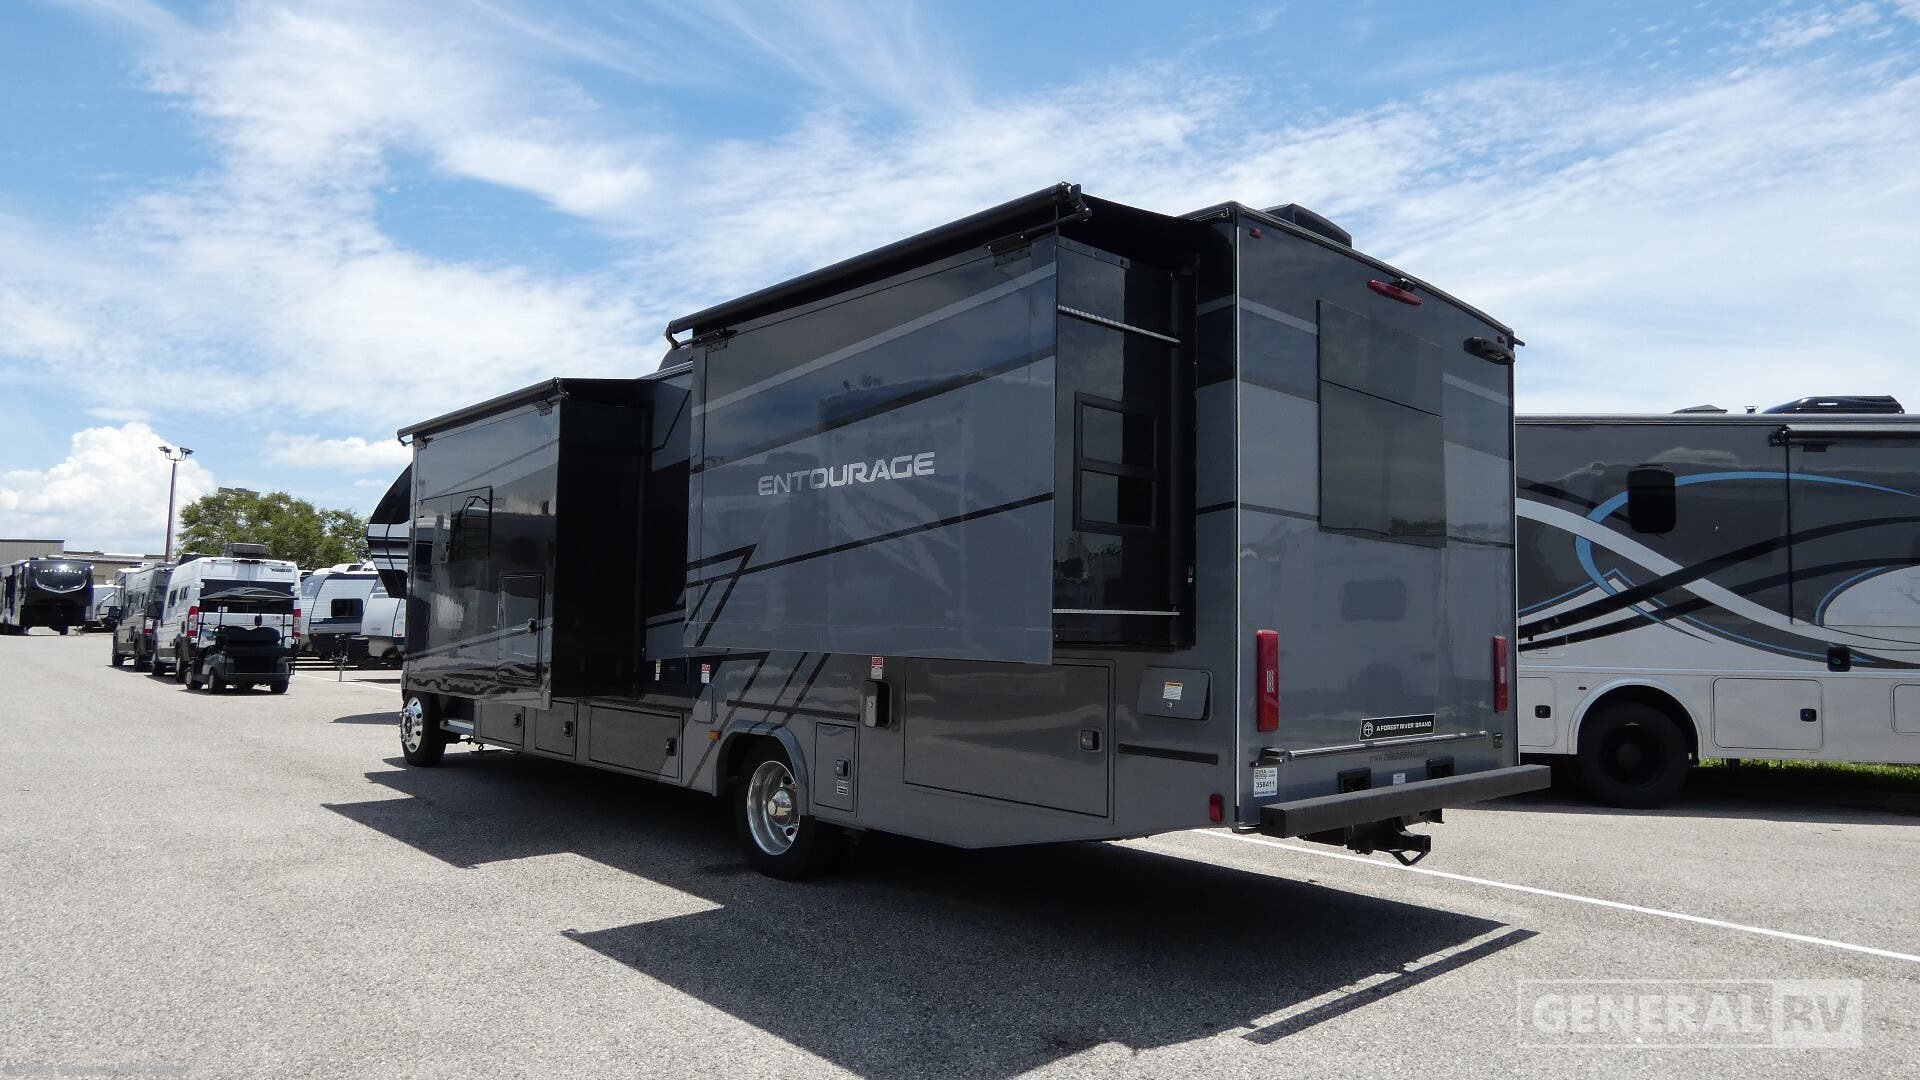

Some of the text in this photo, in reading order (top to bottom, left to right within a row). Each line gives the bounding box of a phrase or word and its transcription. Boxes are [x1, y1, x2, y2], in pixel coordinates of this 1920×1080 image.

[758, 451, 935, 496] ENTOURAGE
[1381, 723, 1400, 731] FOREST
[1400, 722, 1415, 730] RIVER
[1415, 721, 1432, 729] BRAND
